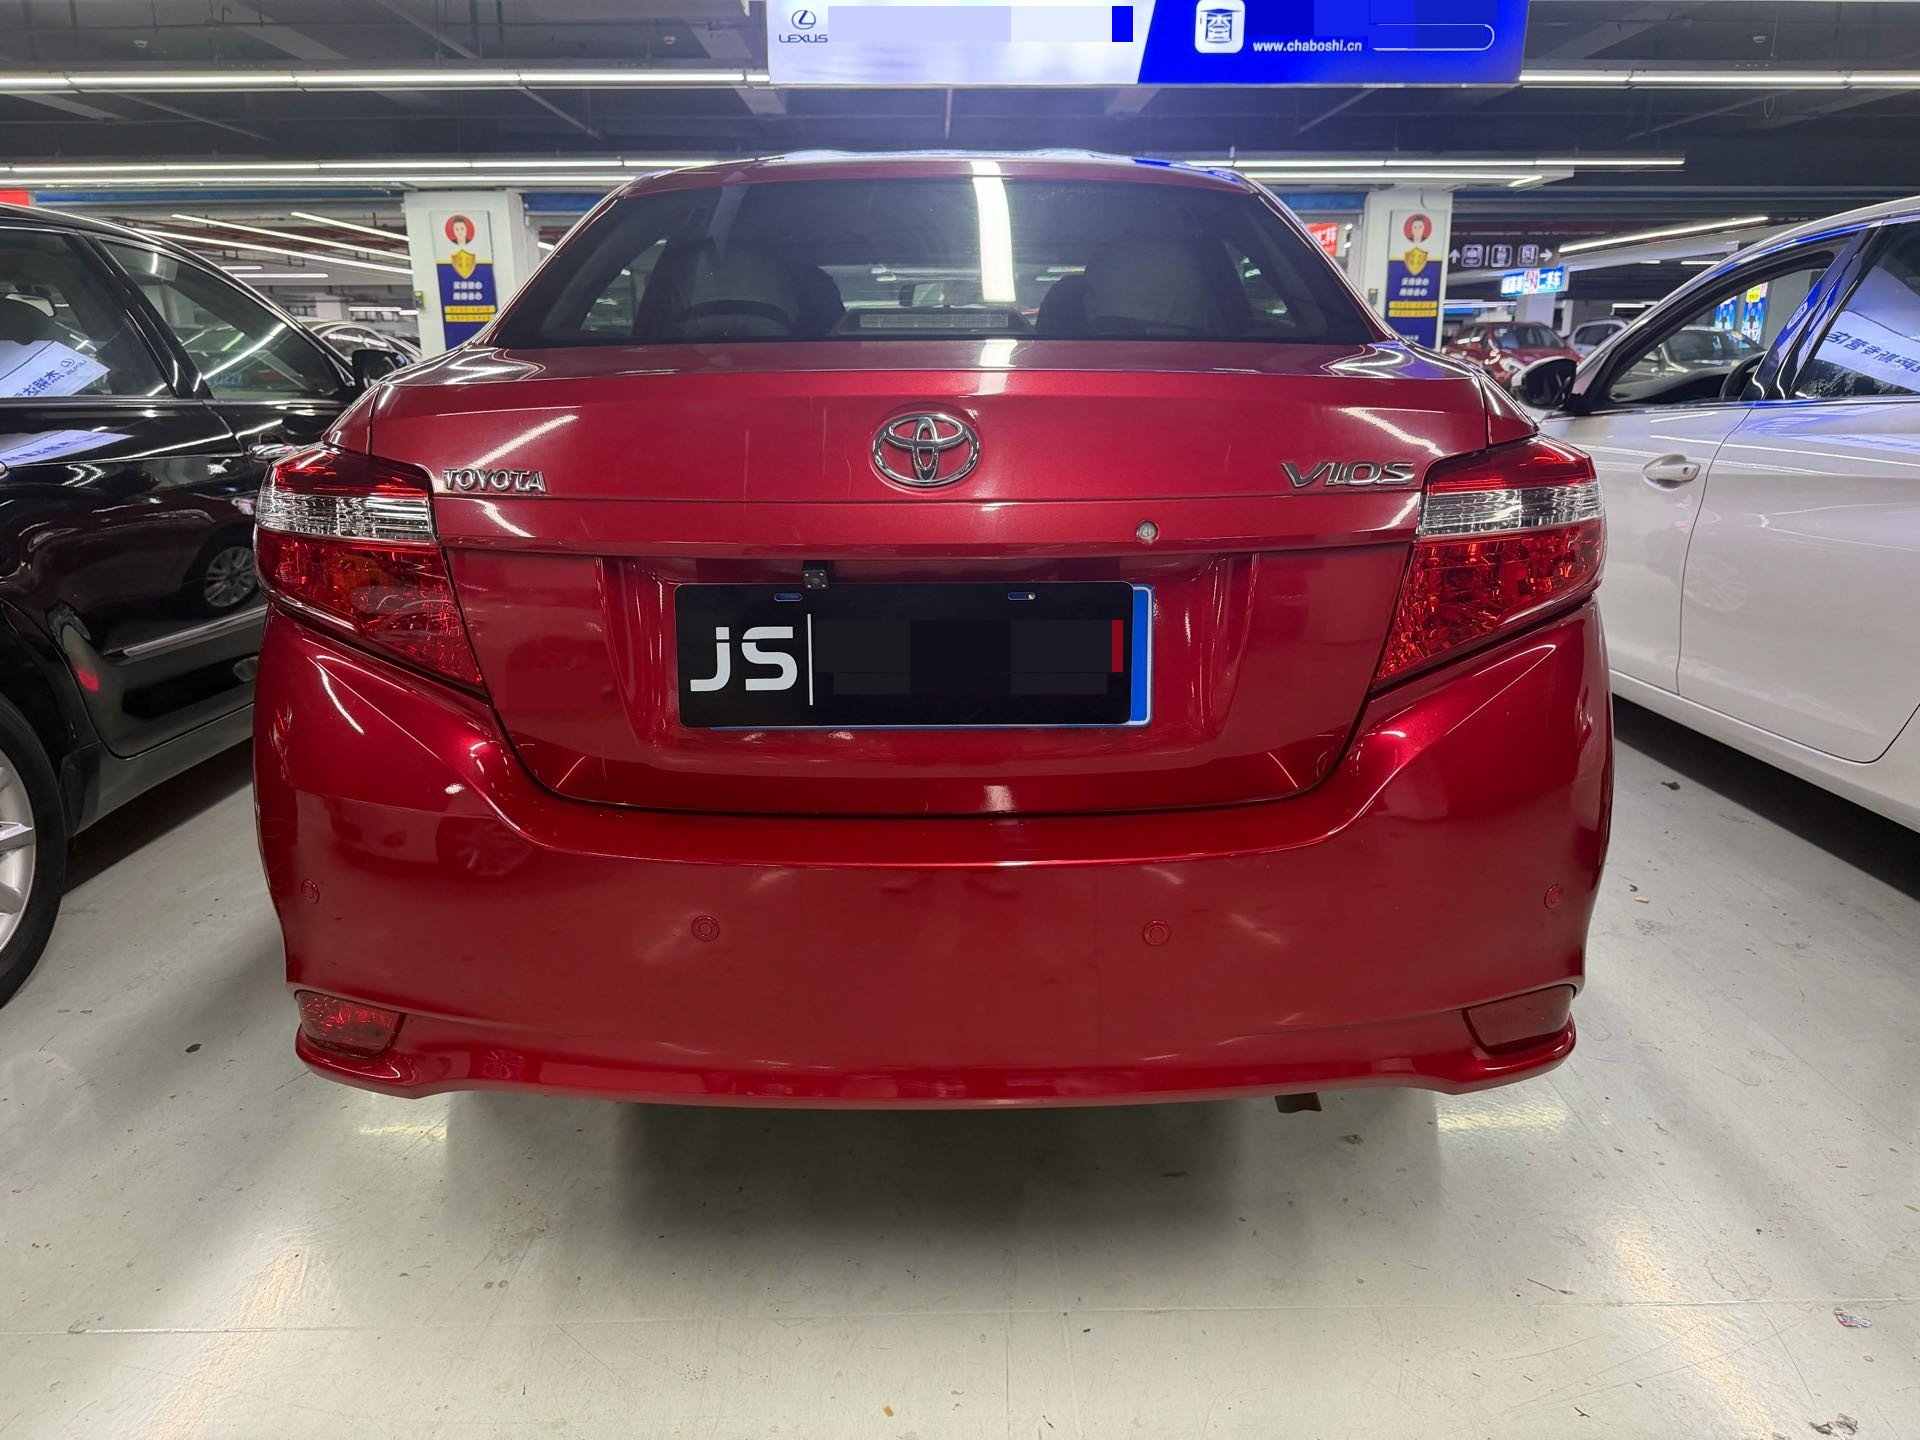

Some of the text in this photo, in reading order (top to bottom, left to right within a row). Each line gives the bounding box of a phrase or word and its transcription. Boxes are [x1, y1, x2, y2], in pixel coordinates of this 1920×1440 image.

[778, 33, 828, 44] LEXUS
[1252, 38, 1363, 52] www.chaboshi.cn
[443, 468, 547, 493] TOYOTA
[1280, 461, 1416, 488] VIOS
